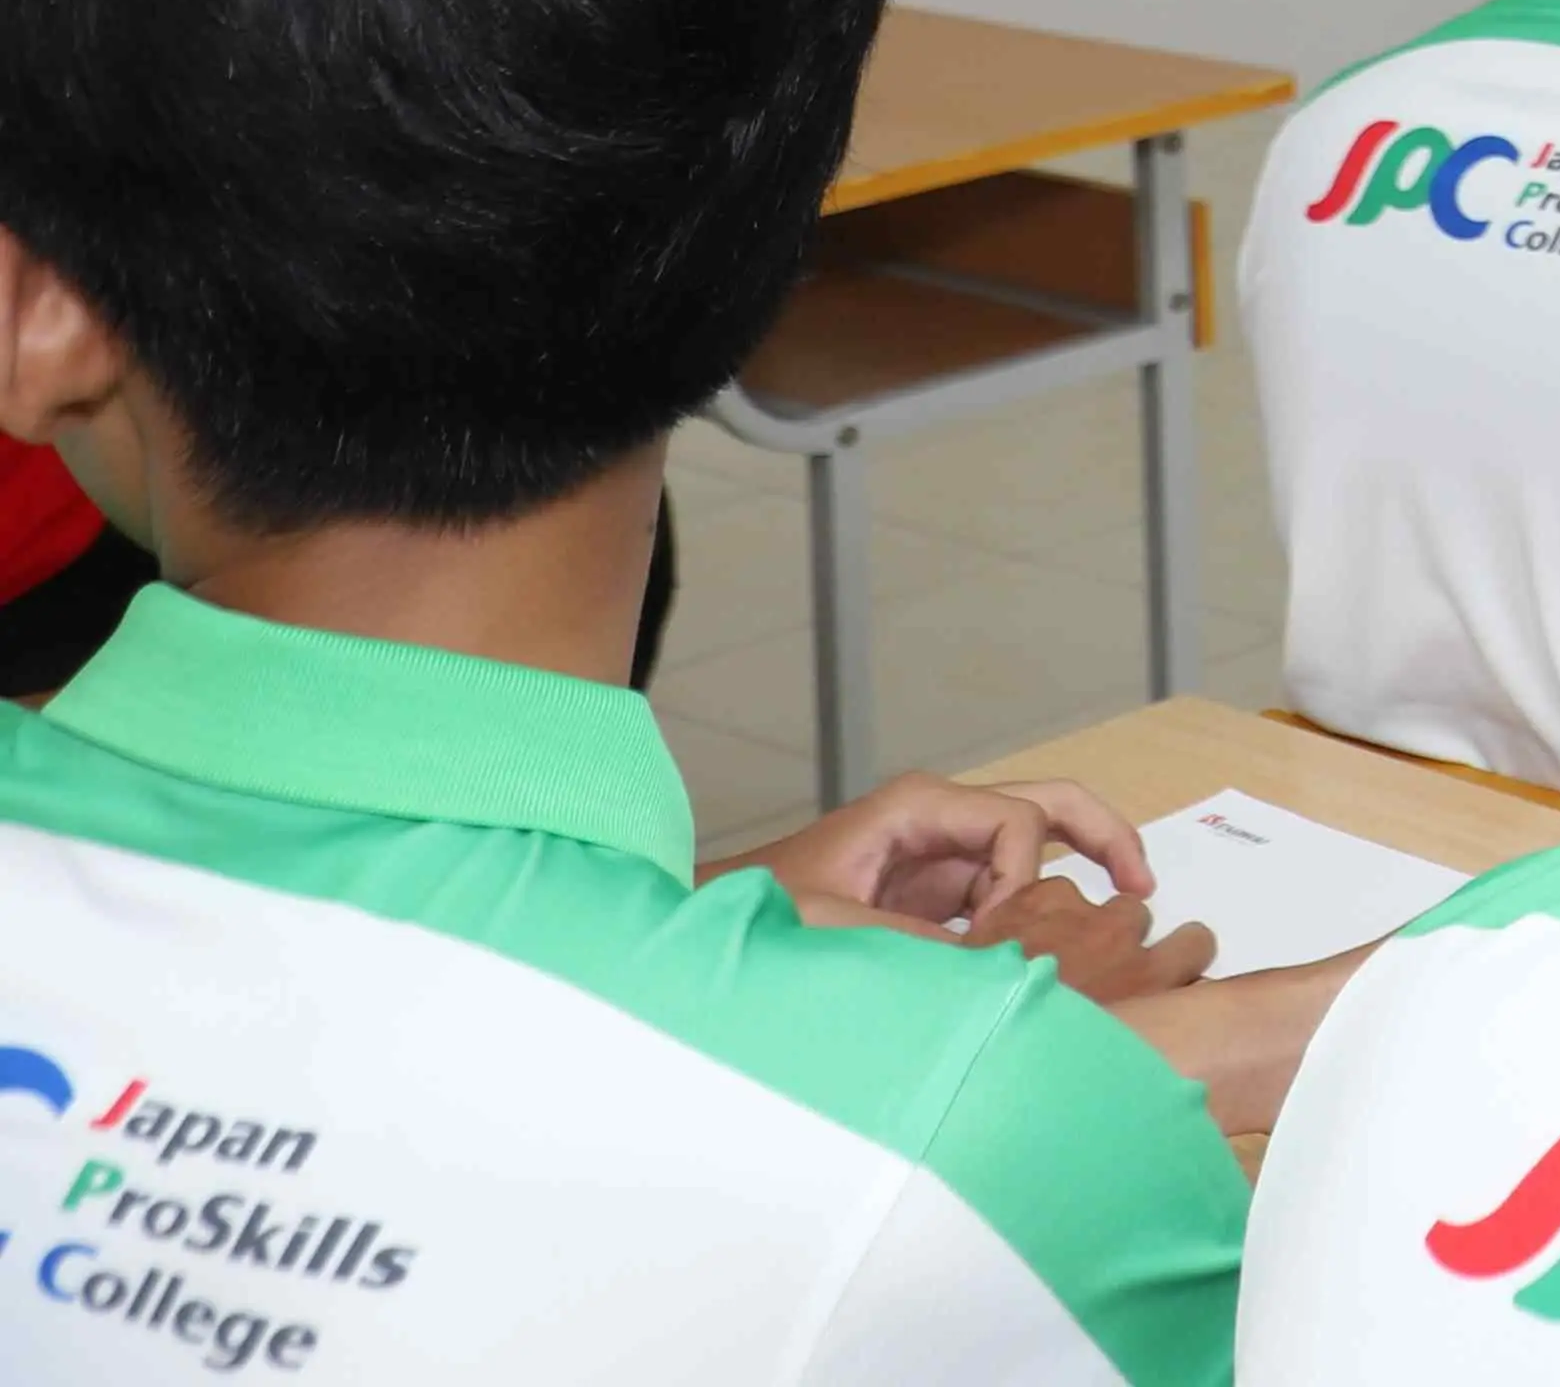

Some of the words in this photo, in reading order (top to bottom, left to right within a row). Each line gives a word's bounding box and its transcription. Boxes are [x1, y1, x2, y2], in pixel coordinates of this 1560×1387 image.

[1306, 120, 1520, 242] JPC
[89, 1077, 318, 1173] Japan
[60, 1158, 417, 1290] ProSkills
[36, 1242, 319, 1373] College
